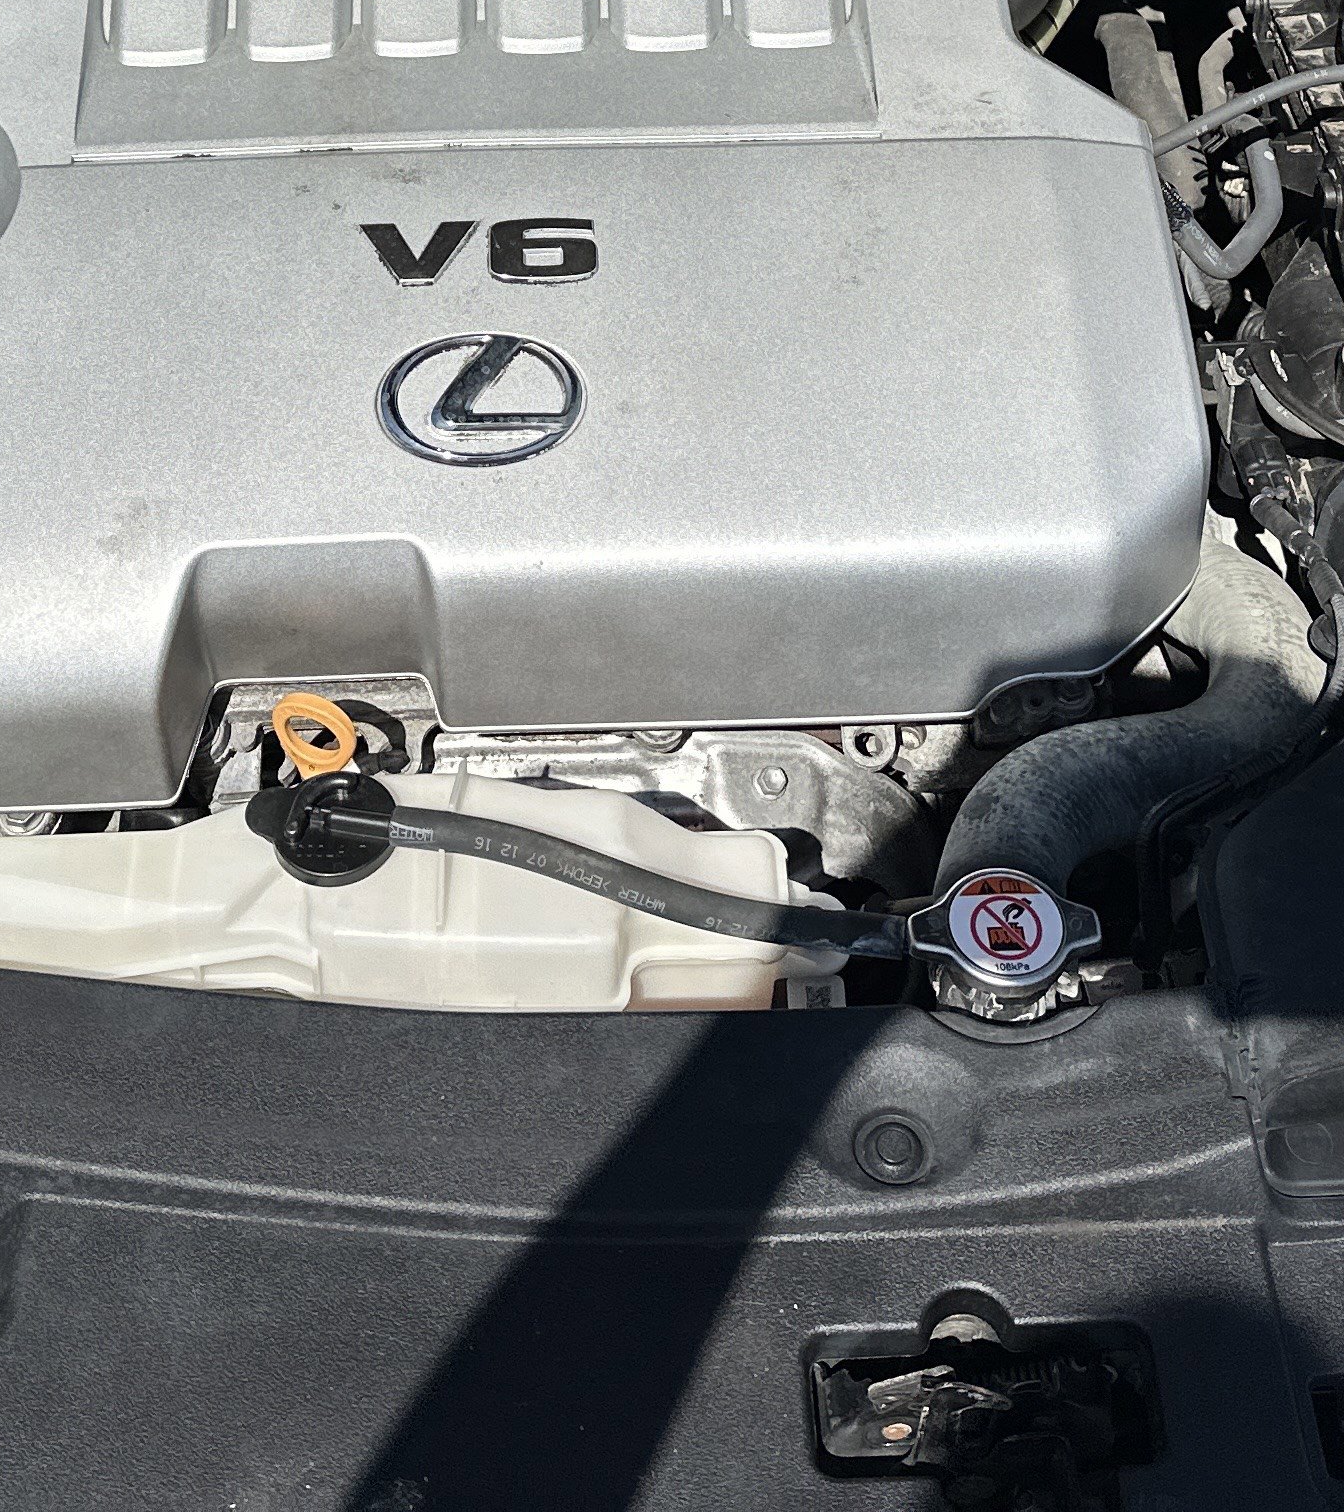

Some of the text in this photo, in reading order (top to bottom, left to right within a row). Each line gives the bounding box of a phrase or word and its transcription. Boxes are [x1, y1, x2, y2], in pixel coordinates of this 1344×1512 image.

[359, 218, 599, 286] V6
[474, 836, 491, 851] 16
[501, 842, 518, 858] 12
[527, 851, 547, 868] 07
[556, 861, 611, 892] >EPDM<
[619, 887, 666, 914] WATER
